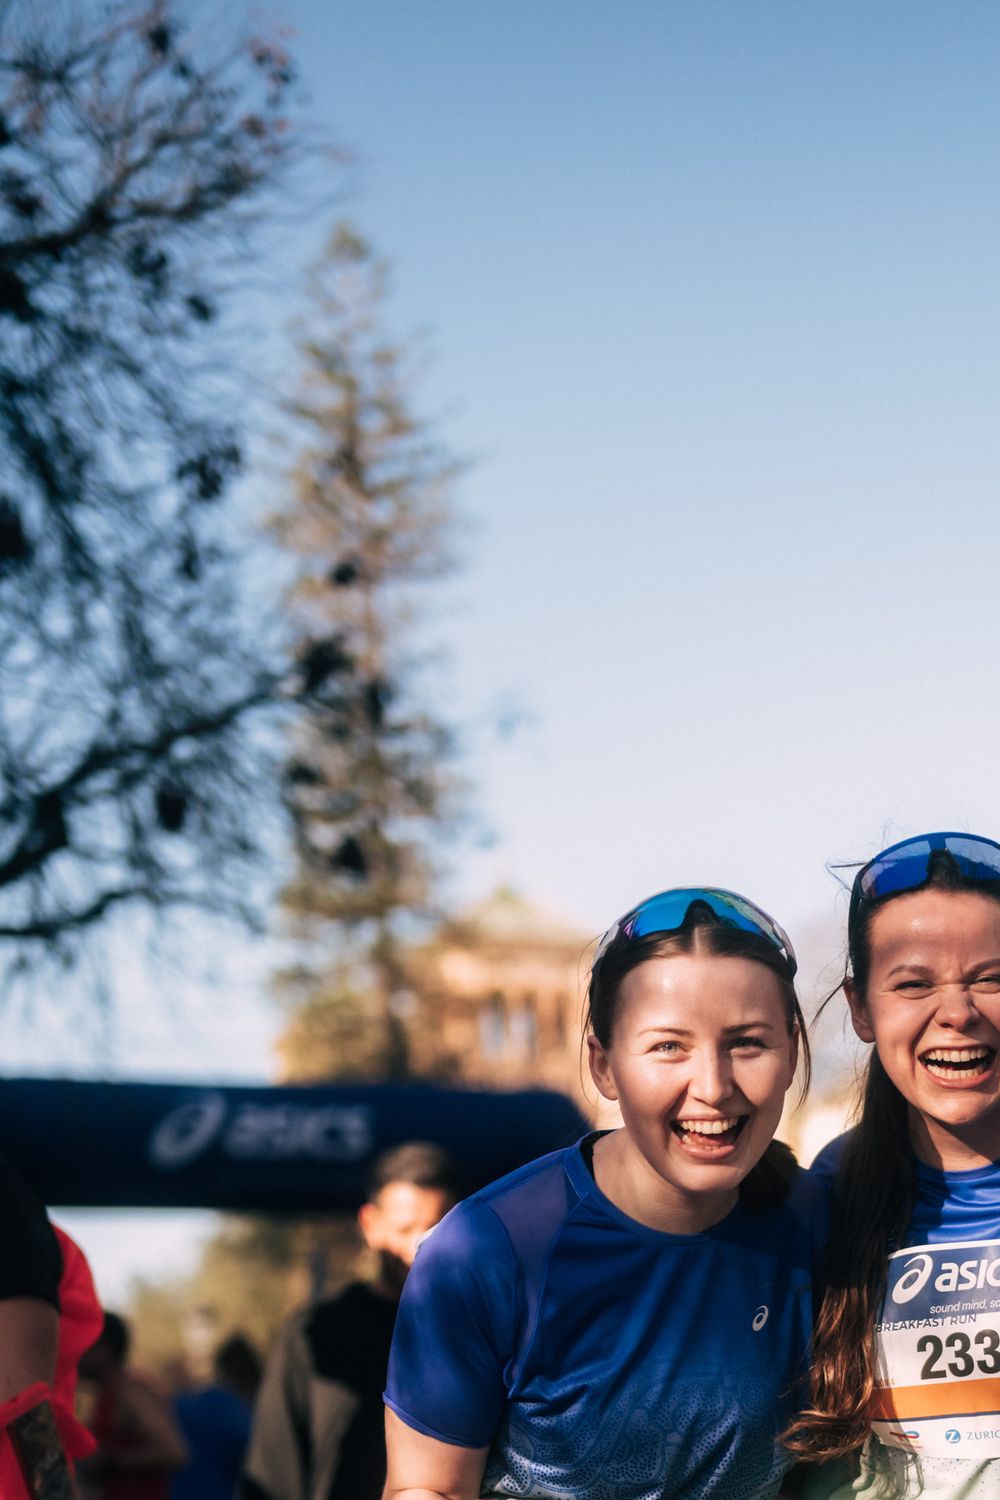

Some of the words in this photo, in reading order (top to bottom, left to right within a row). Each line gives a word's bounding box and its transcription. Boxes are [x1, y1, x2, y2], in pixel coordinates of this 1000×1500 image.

[929, 1301, 961, 1315] sound
[961, 1298, 989, 1312] mind,
[875, 1315, 947, 1333] BREAKFAST
[950, 1313, 978, 1326] RUN
